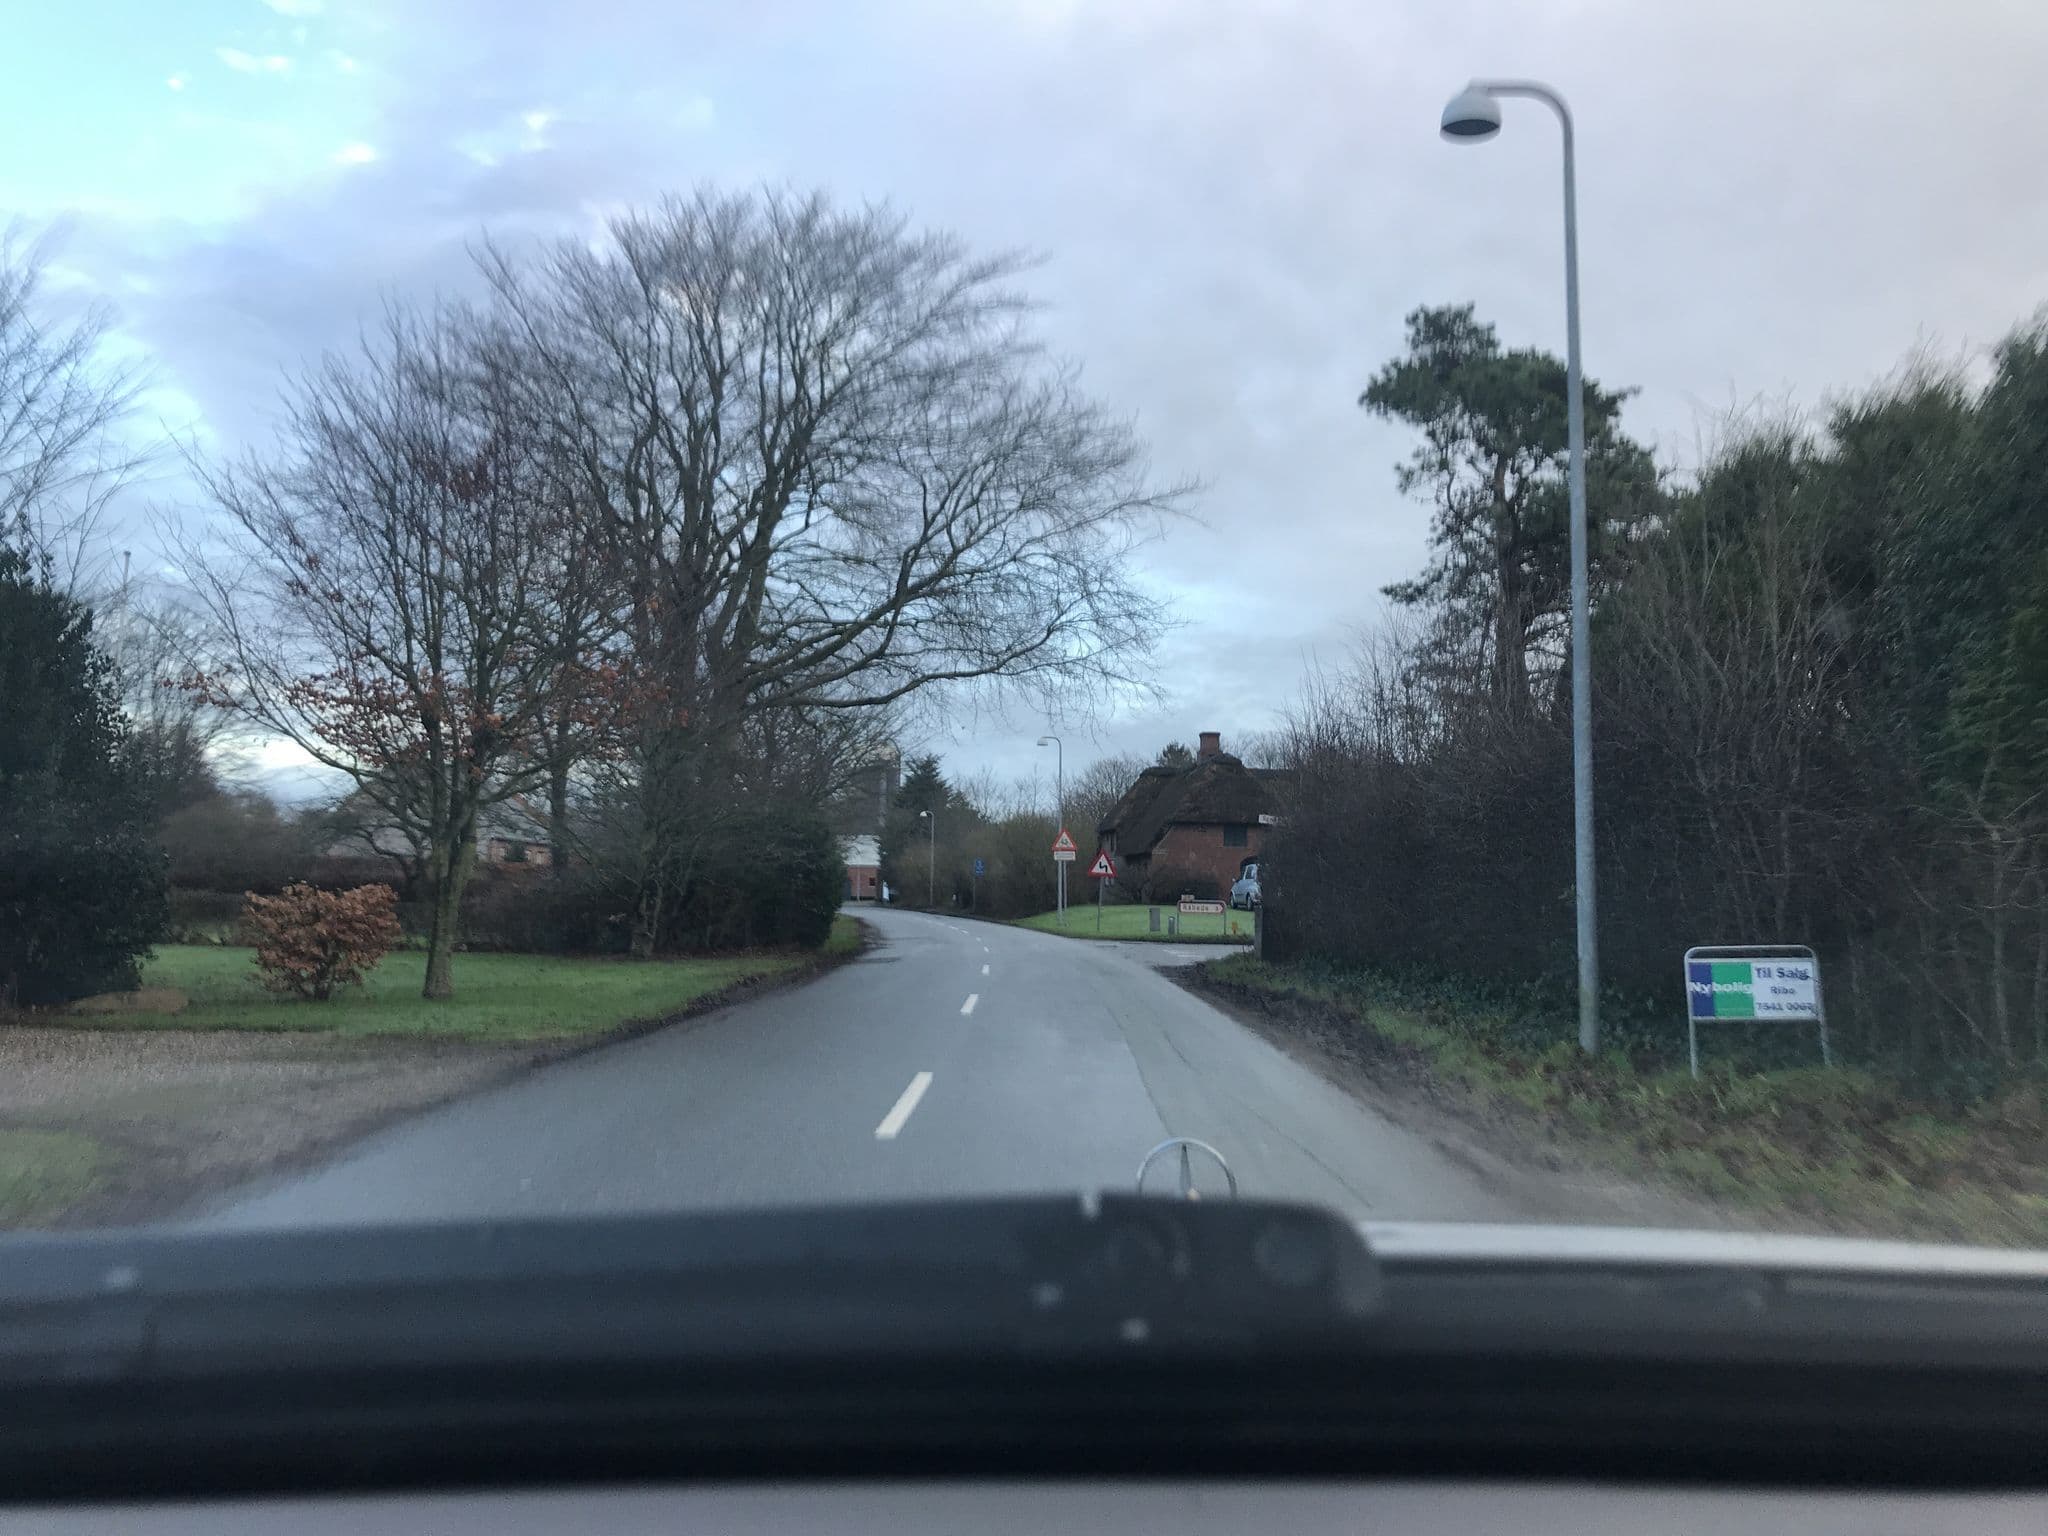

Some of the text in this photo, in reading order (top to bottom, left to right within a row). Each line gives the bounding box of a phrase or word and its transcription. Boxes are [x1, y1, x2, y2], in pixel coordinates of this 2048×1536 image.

[1755, 967, 1810, 980] Til Salg
[1689, 982, 1753, 994] Nybolig
